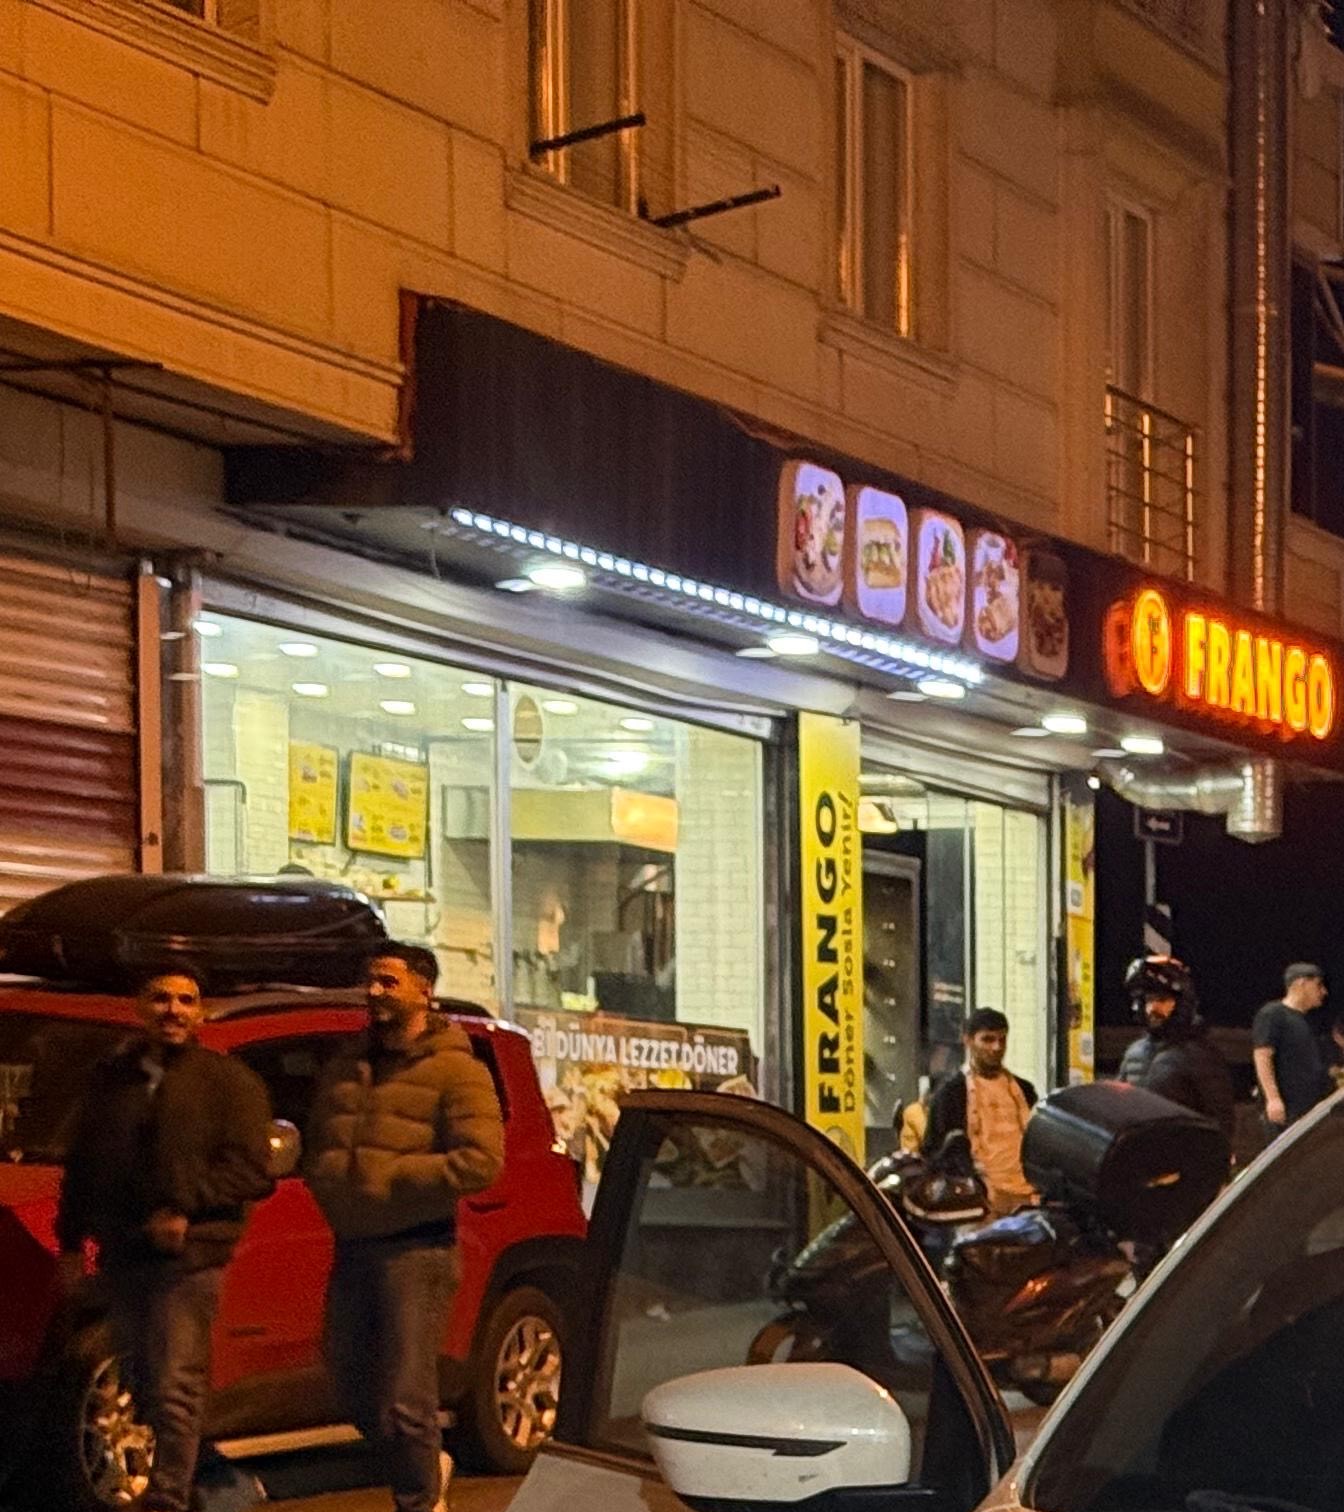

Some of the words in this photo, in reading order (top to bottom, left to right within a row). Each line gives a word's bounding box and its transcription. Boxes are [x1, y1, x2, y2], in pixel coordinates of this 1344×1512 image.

[1184, 612, 1334, 739] FRANGO
[816, 790, 841, 1114] FRANGO
[555, 1022, 617, 1063] DÜNYA
[619, 1035, 680, 1069] LEZZET
[681, 1034, 738, 1076] DÖNER
